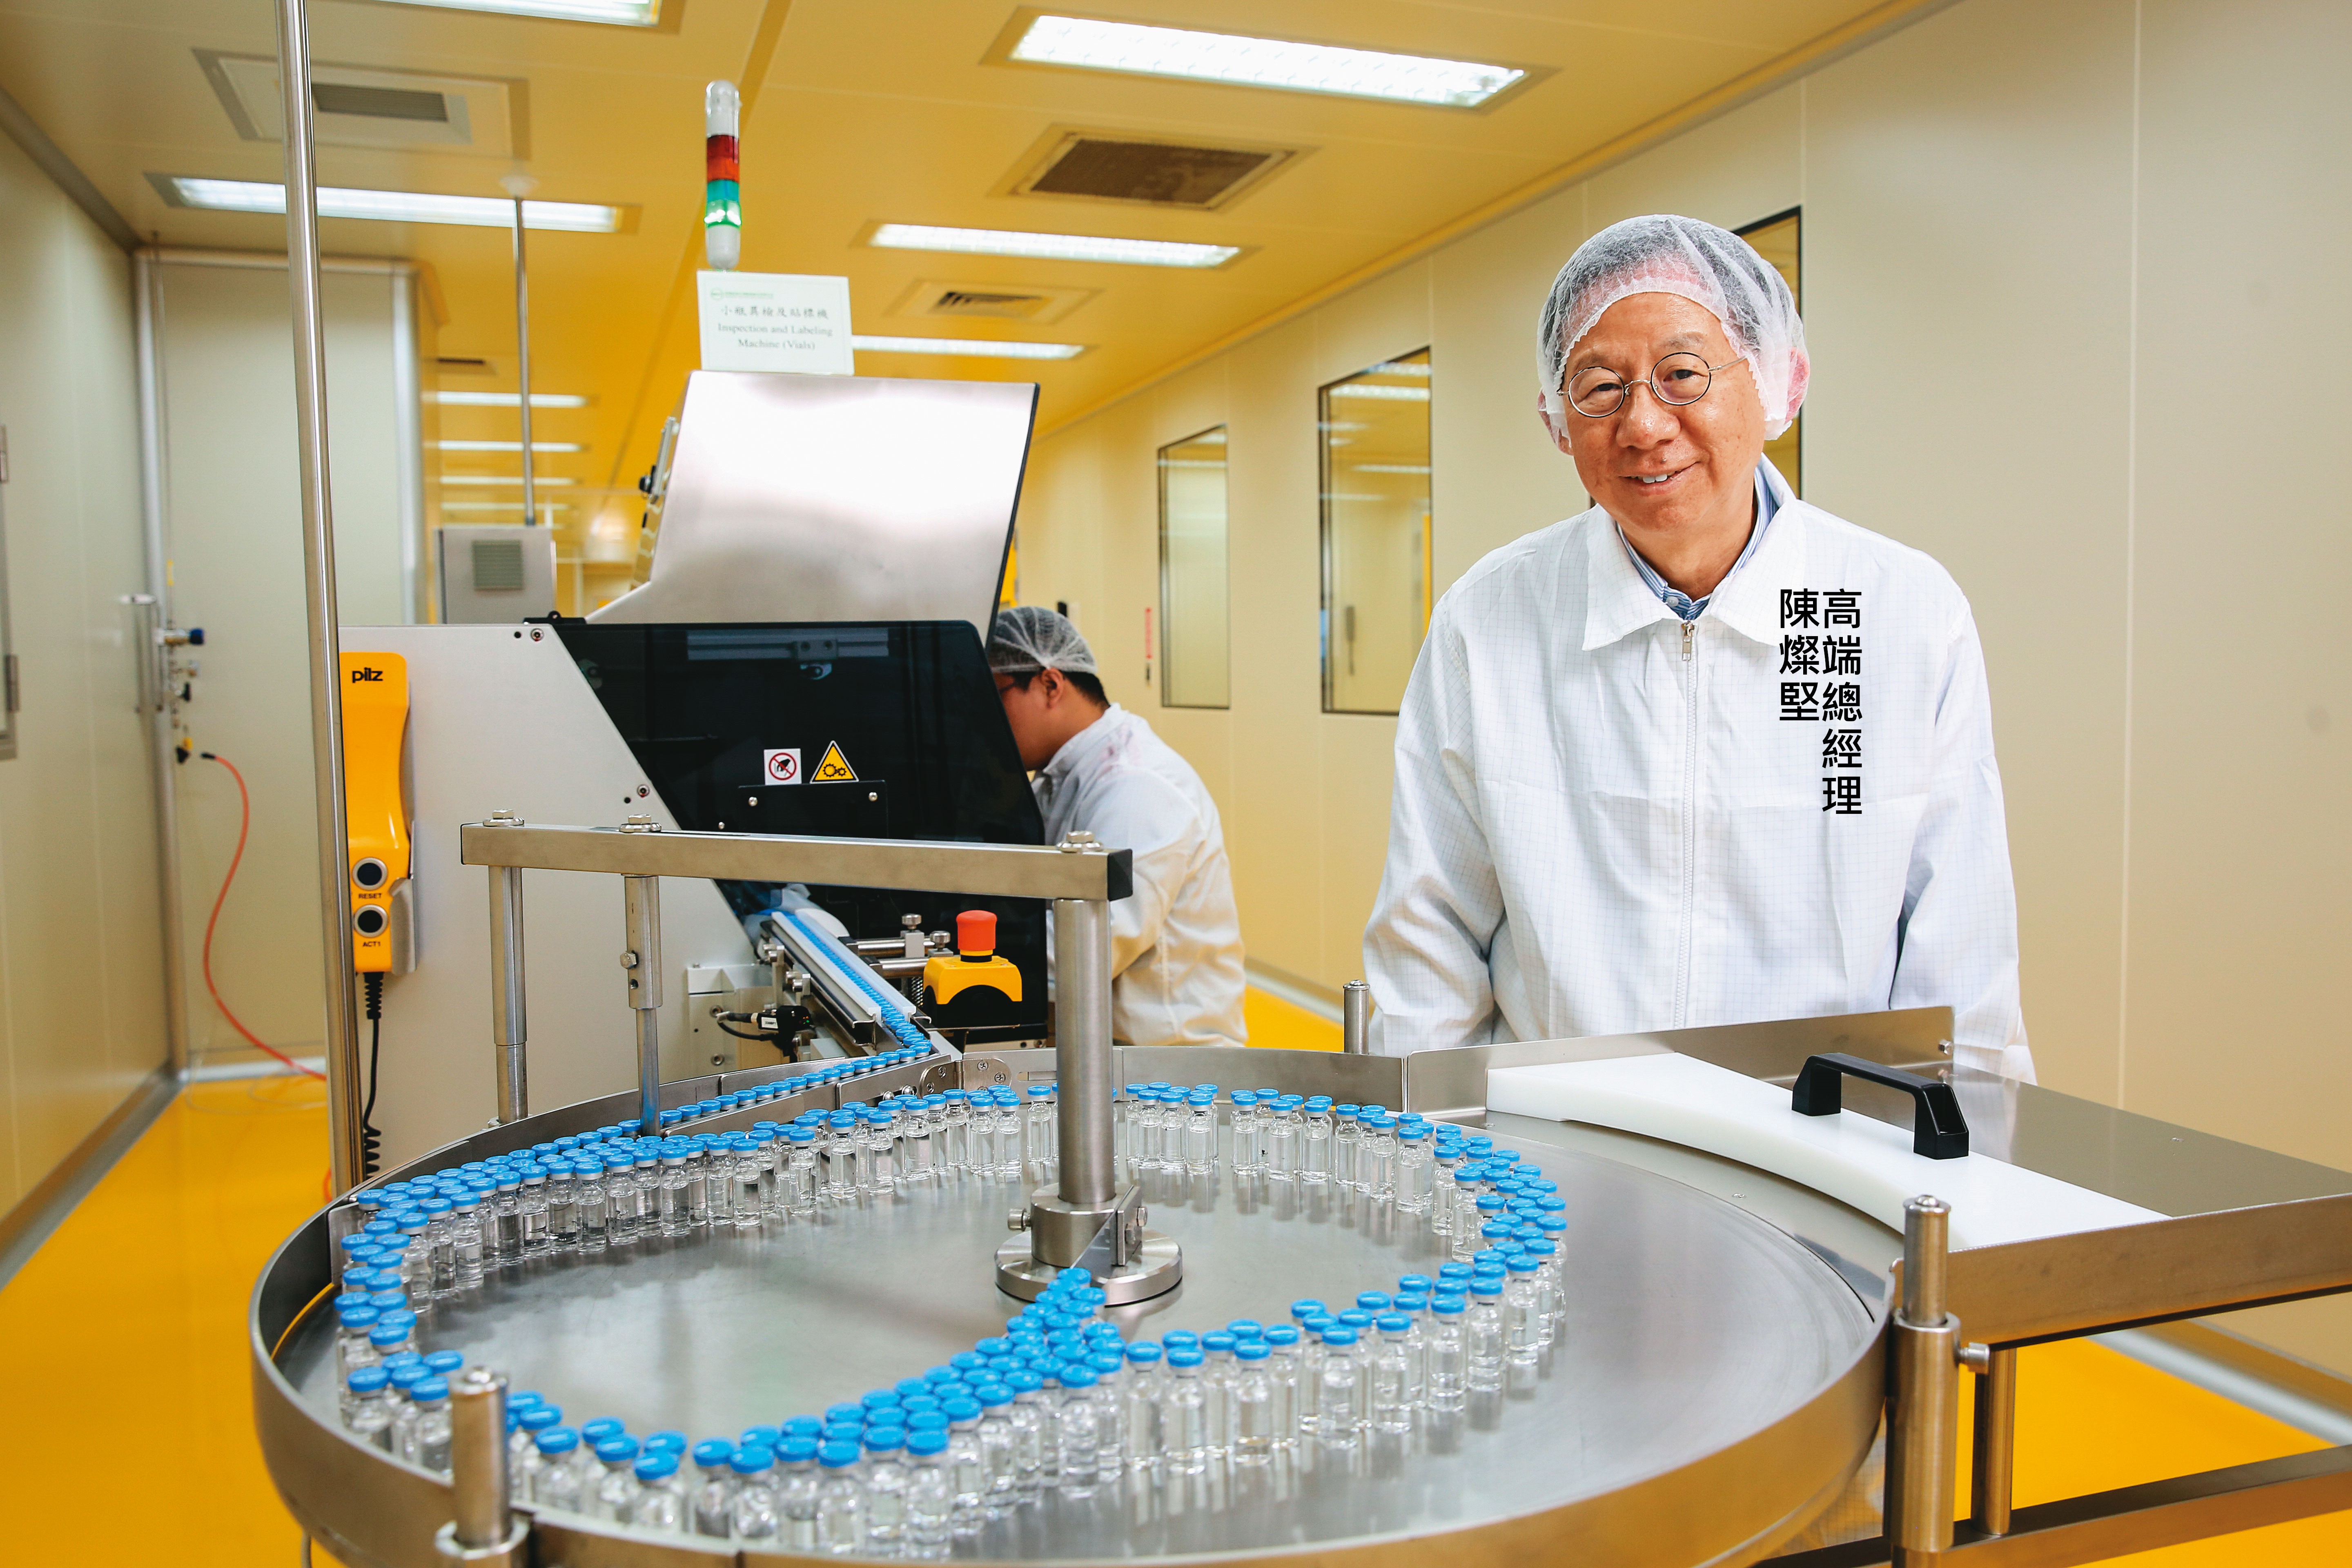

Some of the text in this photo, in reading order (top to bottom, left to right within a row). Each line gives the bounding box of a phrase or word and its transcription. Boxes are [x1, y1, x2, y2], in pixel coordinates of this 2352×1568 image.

[718, 323, 833, 337] Inspection and Labeling
[738, 339, 815, 350] Machine (Vials)
[352, 667, 383, 683] pilz
